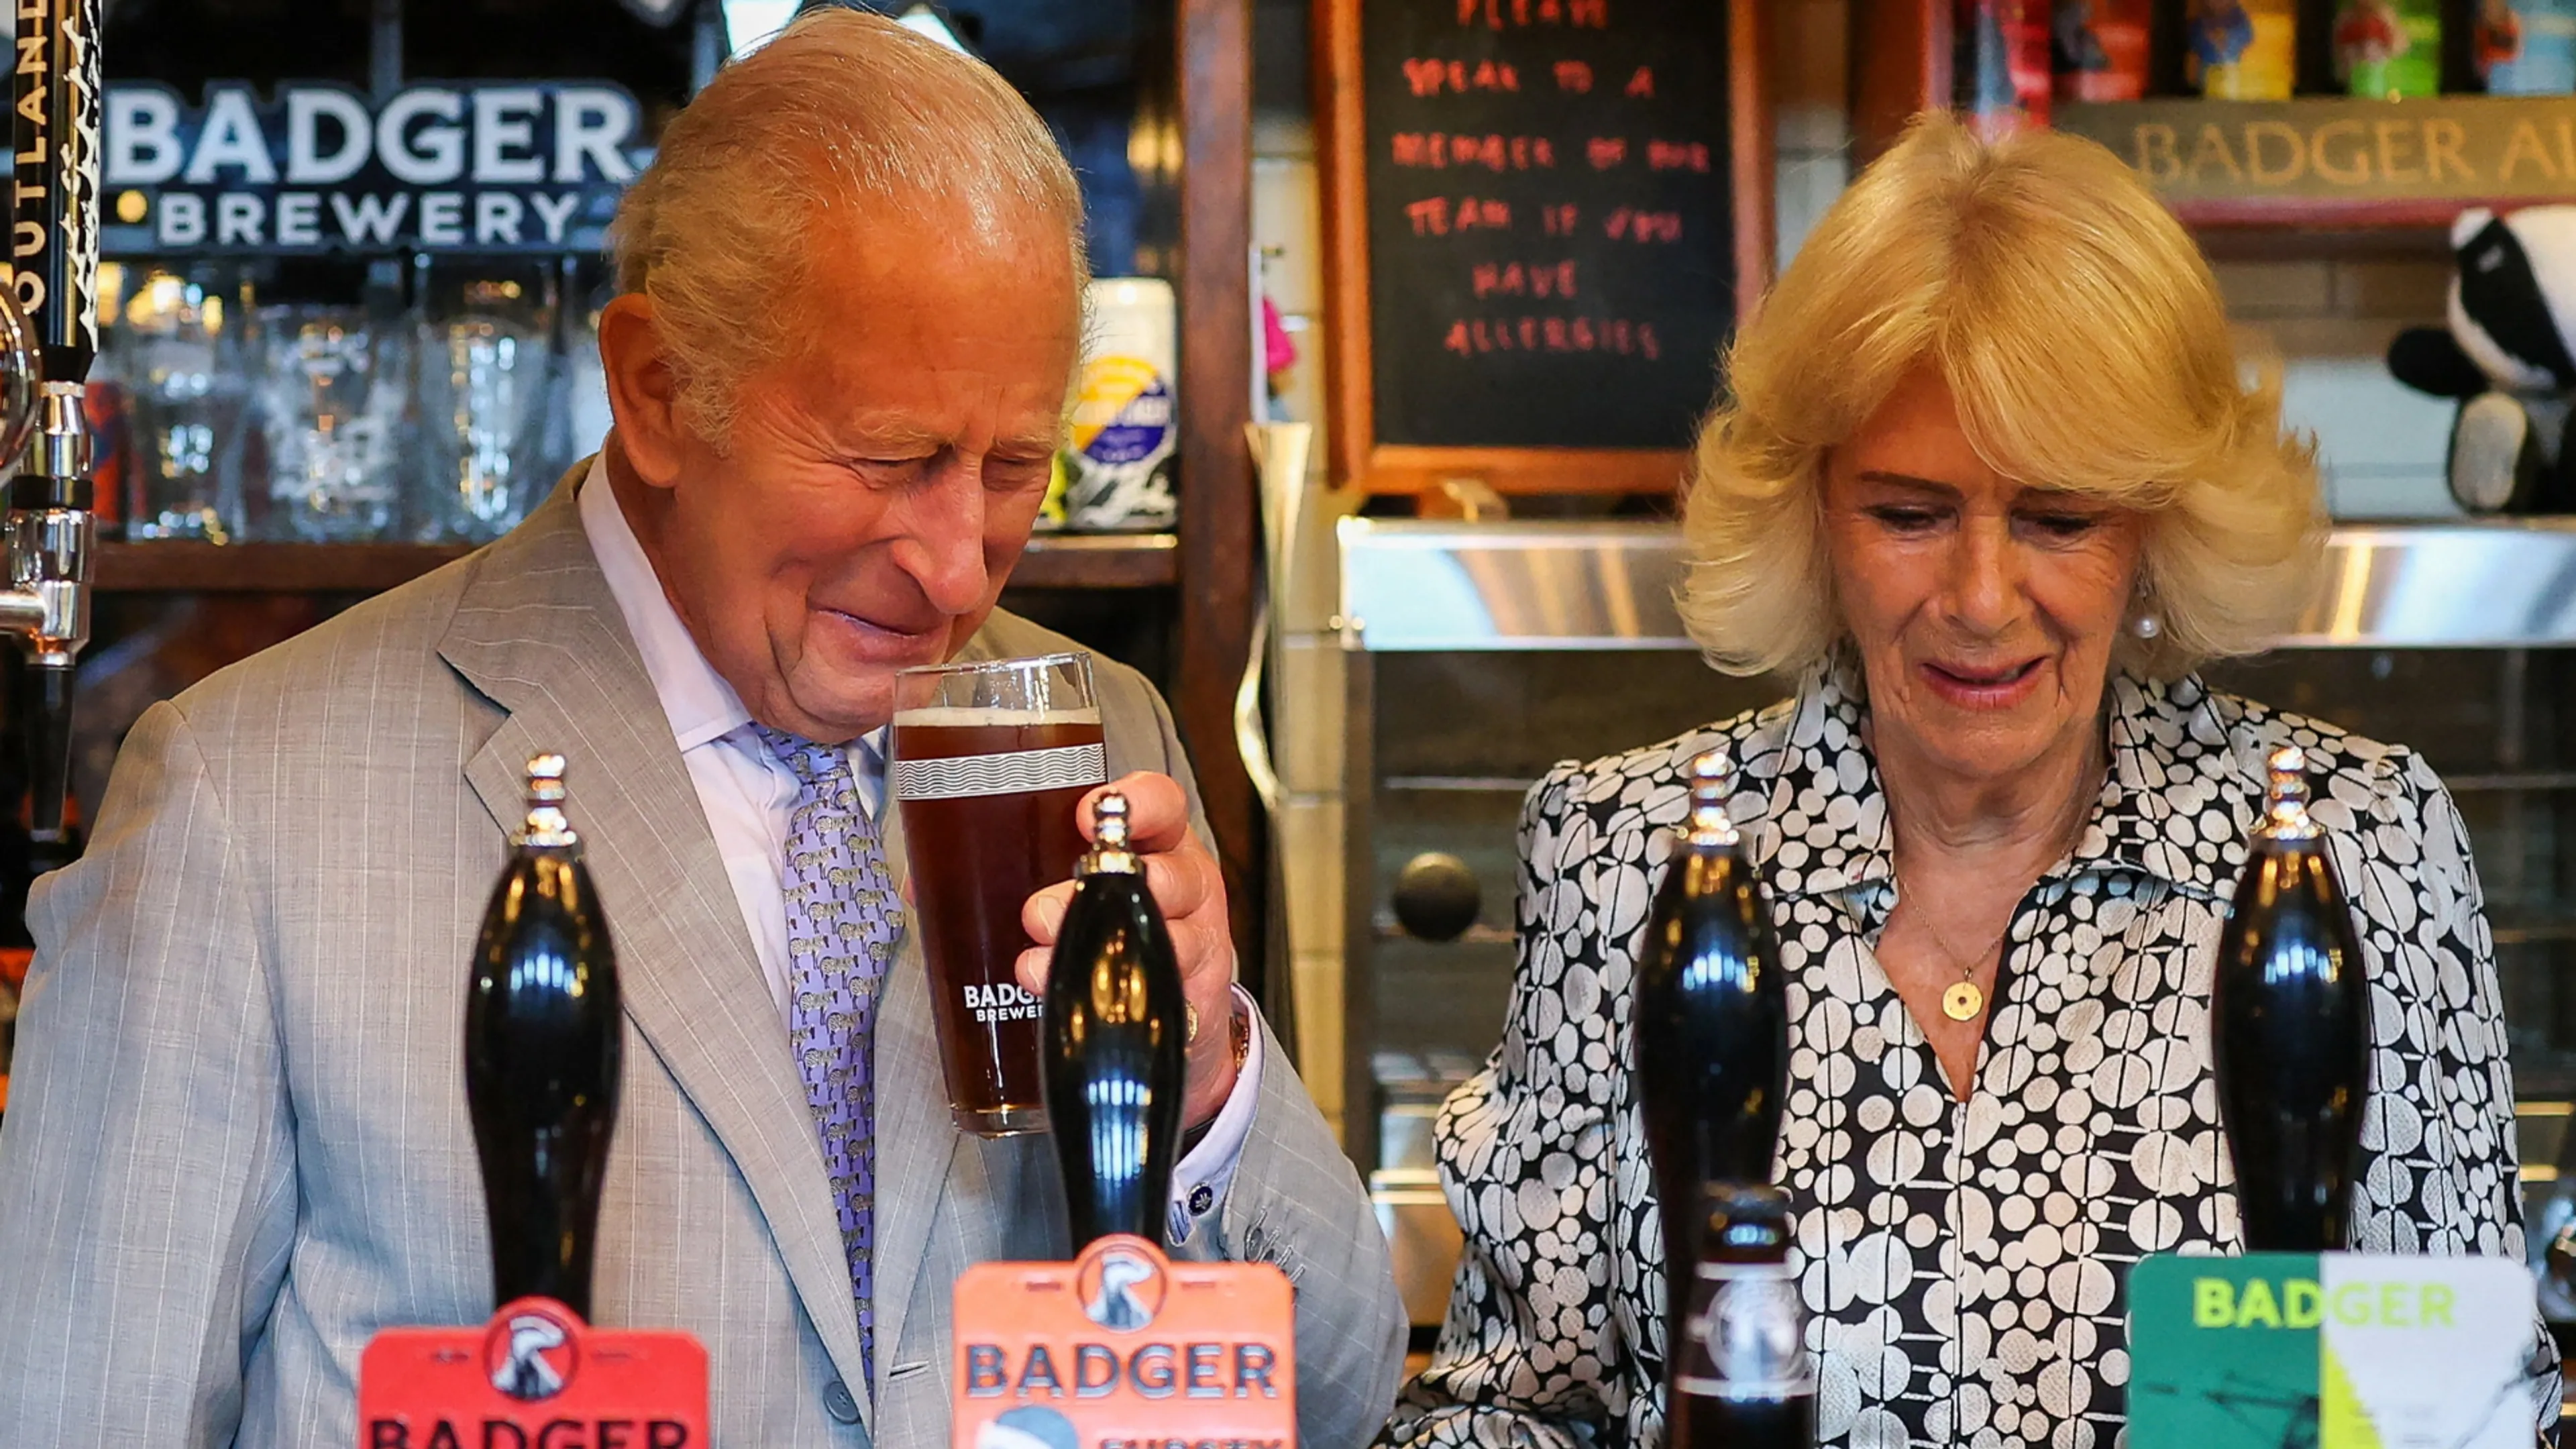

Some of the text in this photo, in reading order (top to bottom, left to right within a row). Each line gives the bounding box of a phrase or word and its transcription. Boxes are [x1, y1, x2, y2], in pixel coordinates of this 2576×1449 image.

[1624, 65, 1656, 99] A
[105, 86, 639, 184] BADGER
[2134, 117, 2477, 186] BADGER
[156, 191, 582, 247] BREWERY
[963, 983, 1044, 1008] BADG
[2192, 1277, 2457, 1329] BADGER
[965, 1342, 1278, 1399] BADGER
